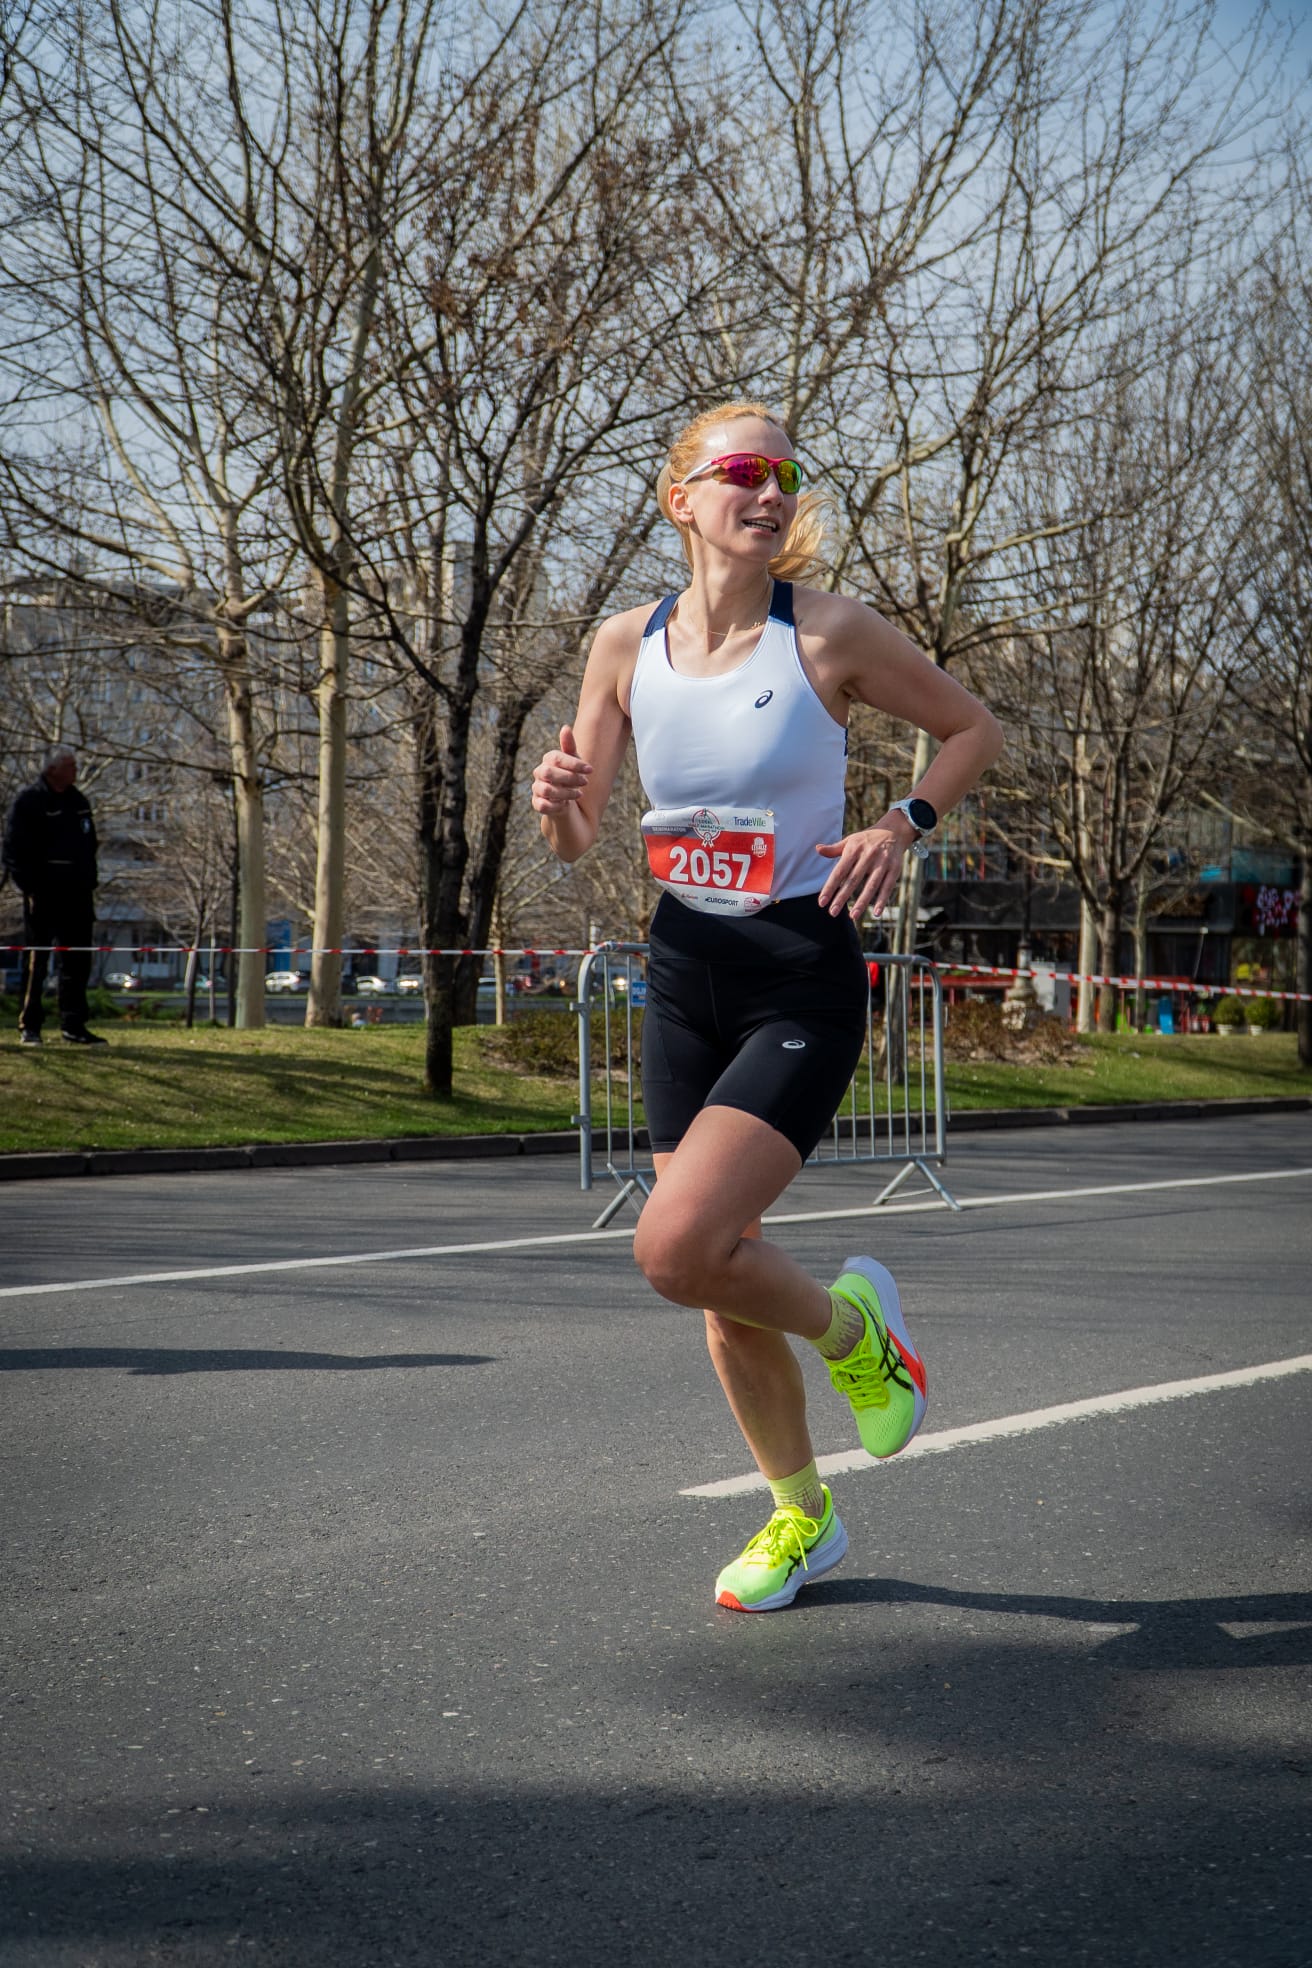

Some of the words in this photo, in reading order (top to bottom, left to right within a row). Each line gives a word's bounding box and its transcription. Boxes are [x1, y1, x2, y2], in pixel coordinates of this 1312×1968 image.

[734, 816, 766, 827] TradeVille
[669, 845, 751, 888] 2057
[706, 897, 739, 906] EUROSPORT
